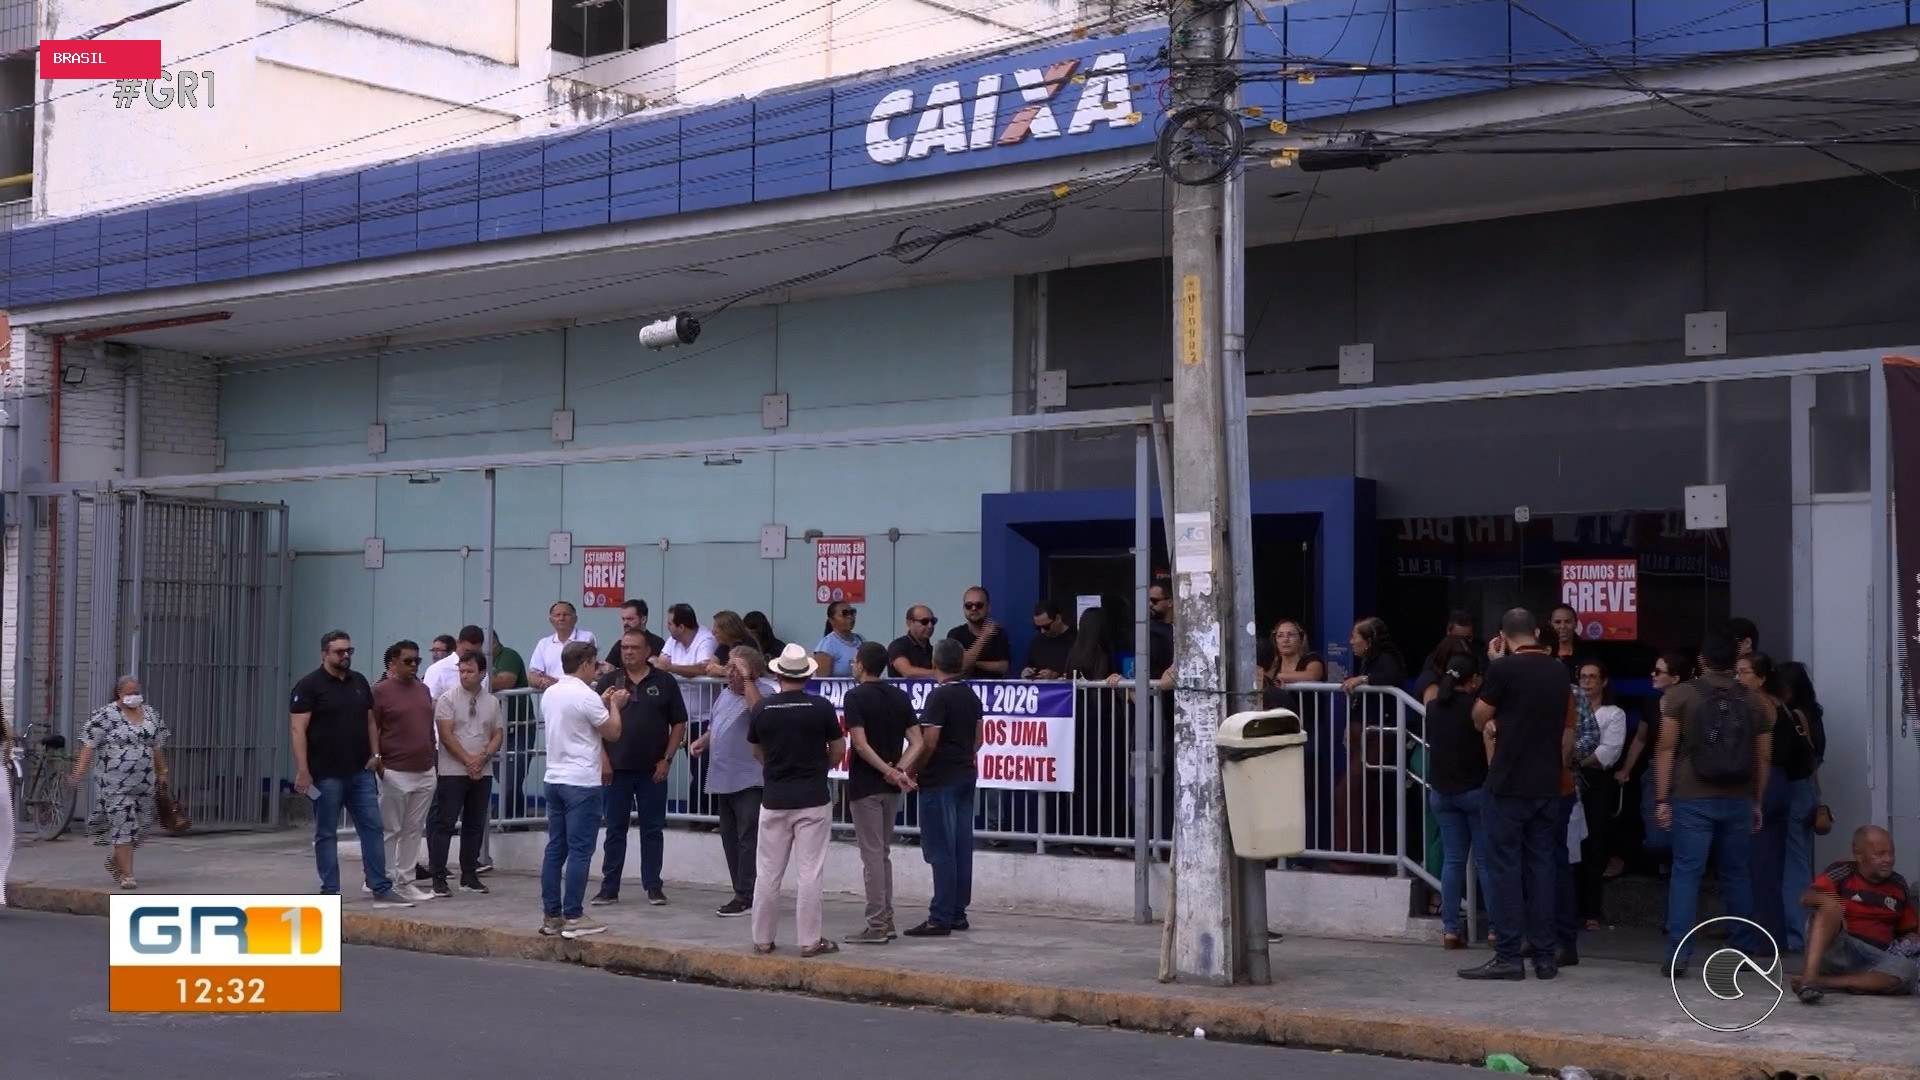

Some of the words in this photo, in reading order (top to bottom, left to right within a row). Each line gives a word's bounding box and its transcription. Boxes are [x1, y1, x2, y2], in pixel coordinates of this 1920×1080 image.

[866, 53, 1141, 165] CAIXA
[585, 552, 613, 563] ESTAMOS
[615, 551, 625, 562] EM
[818, 543, 851, 556] ESTAMOS
[853, 541, 865, 554] EM
[584, 565, 625, 588] GREVE
[818, 555, 865, 582] GREVE
[1563, 565, 1615, 580] ESTAMOS
[1618, 564, 1635, 579] EM
[1562, 581, 1637, 613] GREVE
[992, 685, 1039, 714] 2026
[1011, 721, 1048, 747] UMA
[983, 754, 1057, 782] DECENTE
